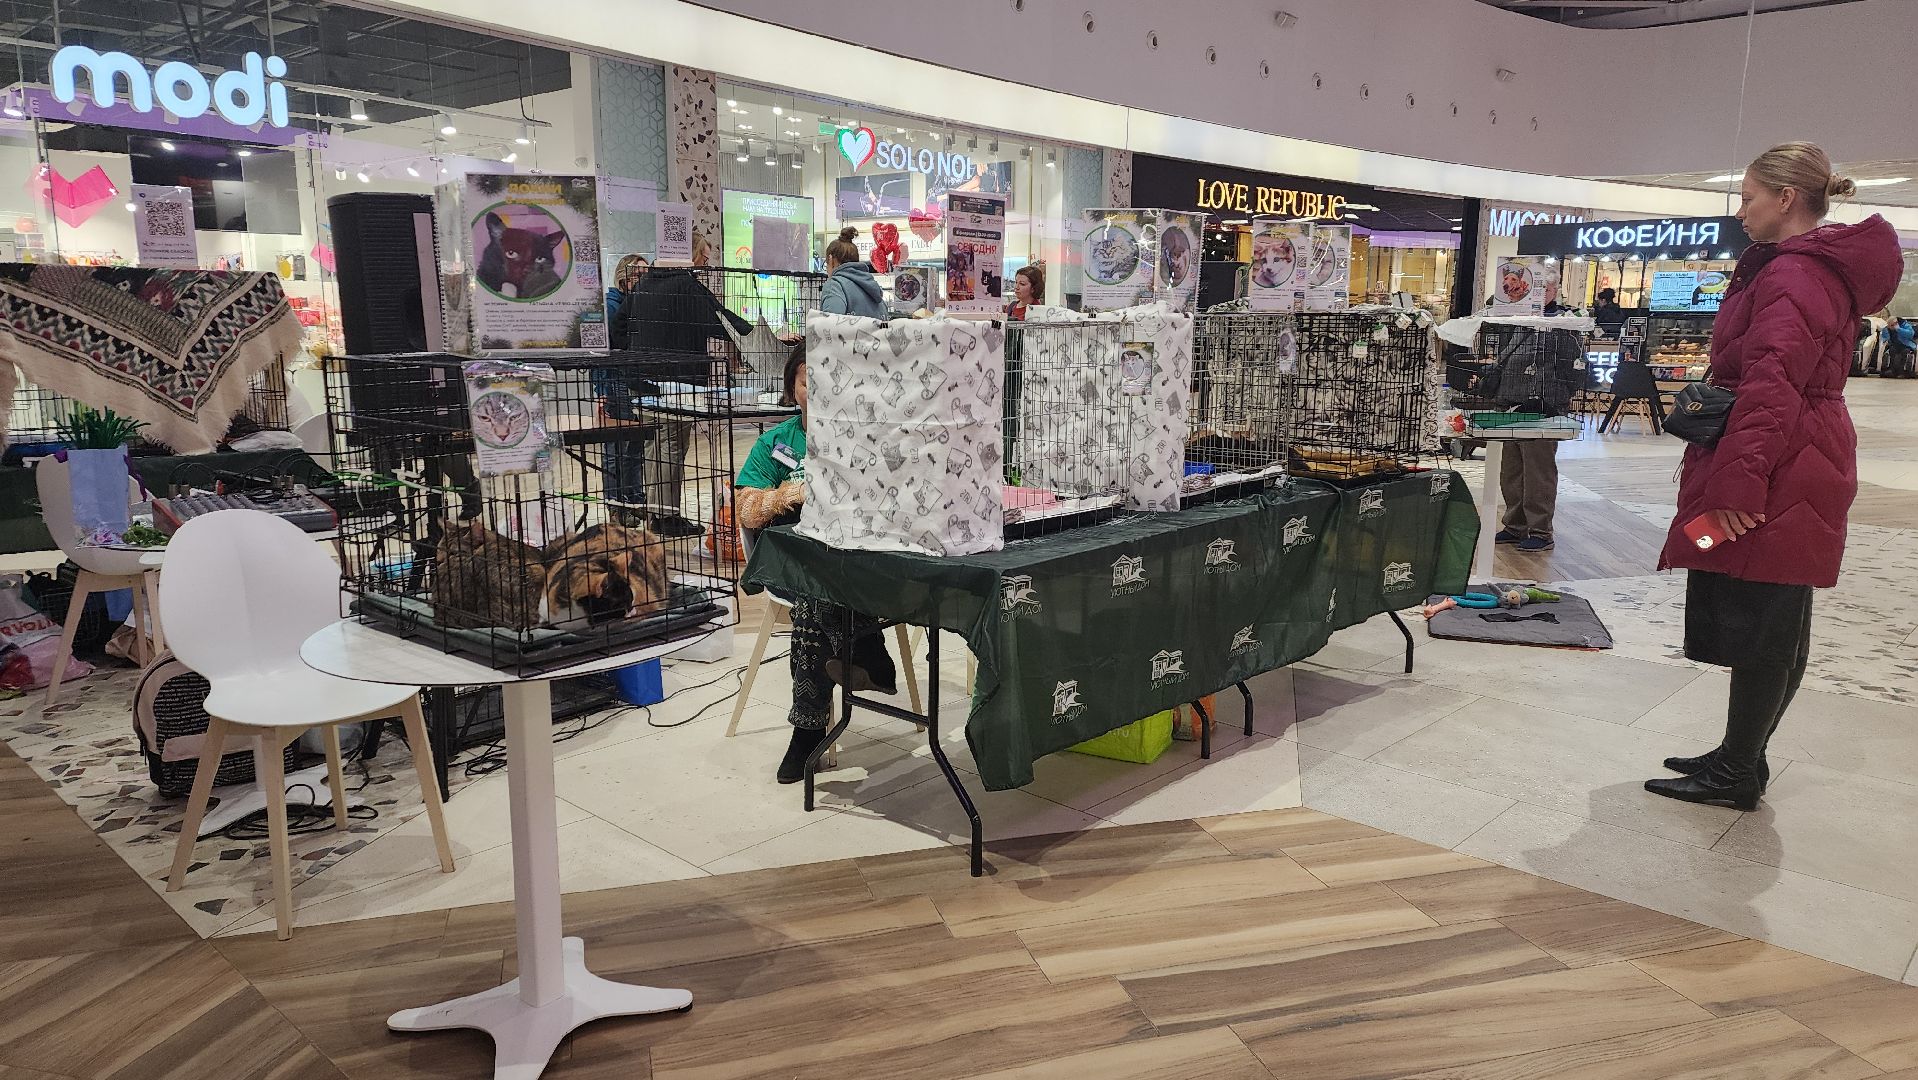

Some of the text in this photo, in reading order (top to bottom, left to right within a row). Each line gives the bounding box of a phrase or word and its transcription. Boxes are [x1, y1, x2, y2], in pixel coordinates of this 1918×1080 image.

[50, 45, 289, 129] modi
[876, 141, 934, 174] SOLO
[1197, 178, 1346, 220] LOVE REPUBLIC
[958, 242, 997, 255] СЕГОДНЯ
[1576, 220, 1720, 249] КОФЕЙНЯ
